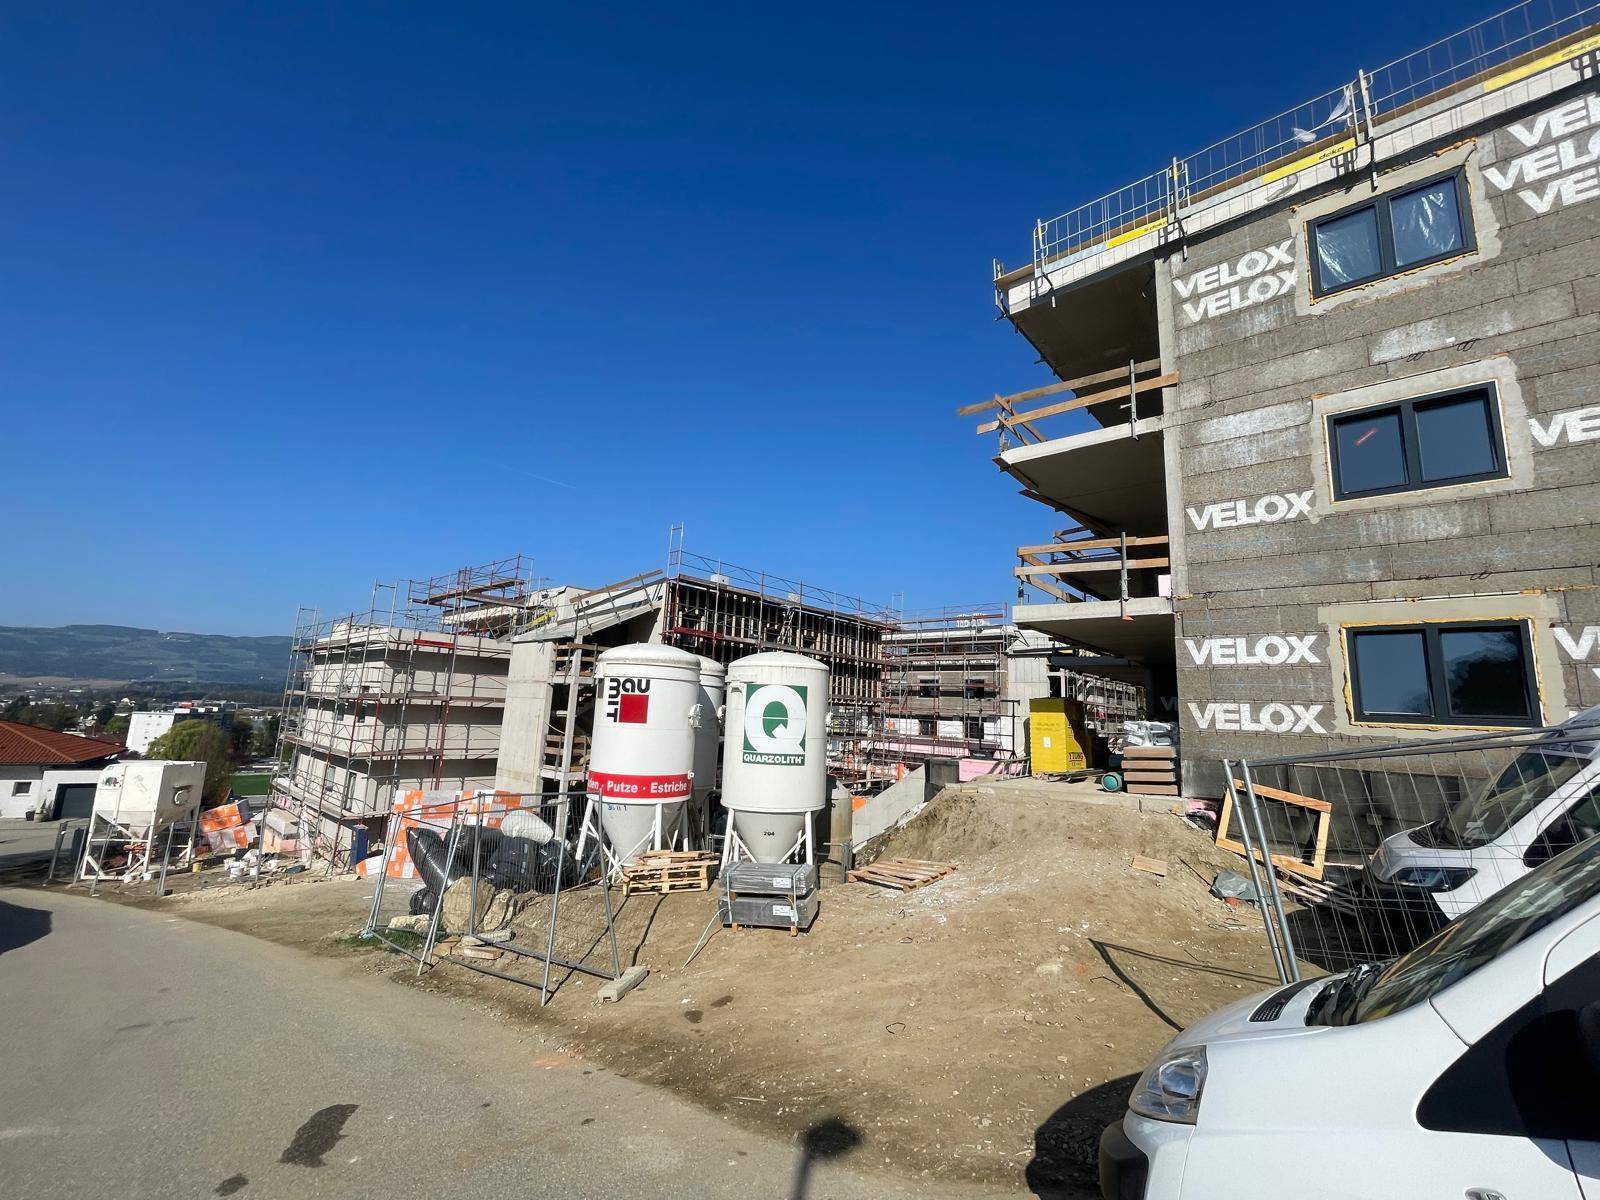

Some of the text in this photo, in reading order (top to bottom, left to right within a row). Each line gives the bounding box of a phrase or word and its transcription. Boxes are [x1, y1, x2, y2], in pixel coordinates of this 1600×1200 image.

[1482, 128, 1600, 191] VEL
[1517, 166, 1600, 214] VE
[1172, 238, 1295, 298] VELOX
[1182, 268, 1299, 322] VELOX
[1186, 489, 1315, 530] VELOX
[1184, 634, 1322, 666] VELOX
[1186, 702, 1328, 734] VELOX
[743, 753, 802, 764] QUARZOLITH
[606, 780, 638, 793] Putze
[650, 781, 688, 794] Estriche
